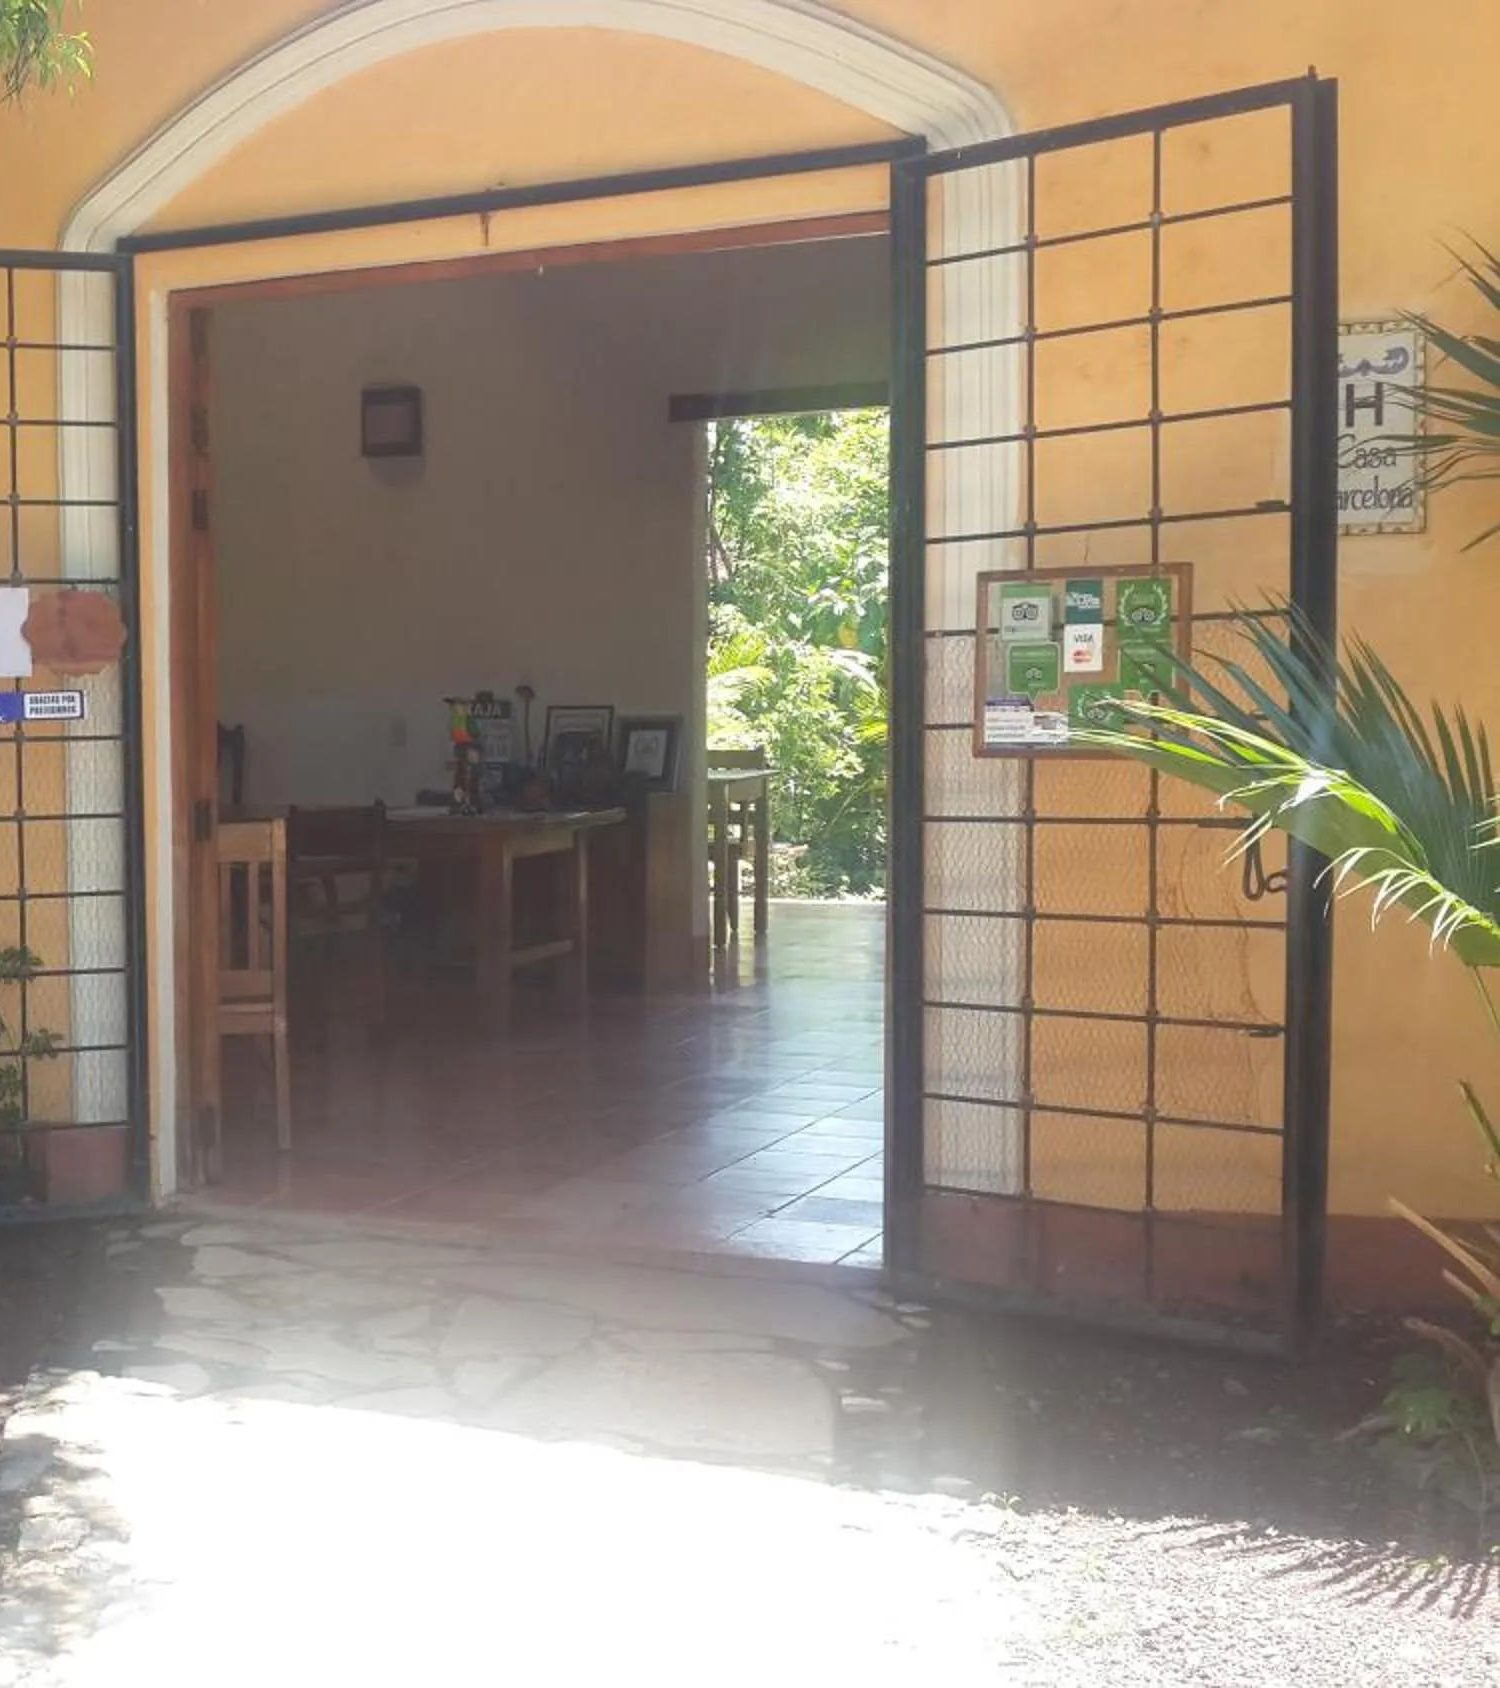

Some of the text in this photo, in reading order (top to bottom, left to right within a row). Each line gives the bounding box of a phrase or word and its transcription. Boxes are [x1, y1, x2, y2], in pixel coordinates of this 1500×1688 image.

[1345, 383, 1383, 427] H
[1338, 476, 1413, 512] arcelona
[469, 703, 501, 716] AJA
